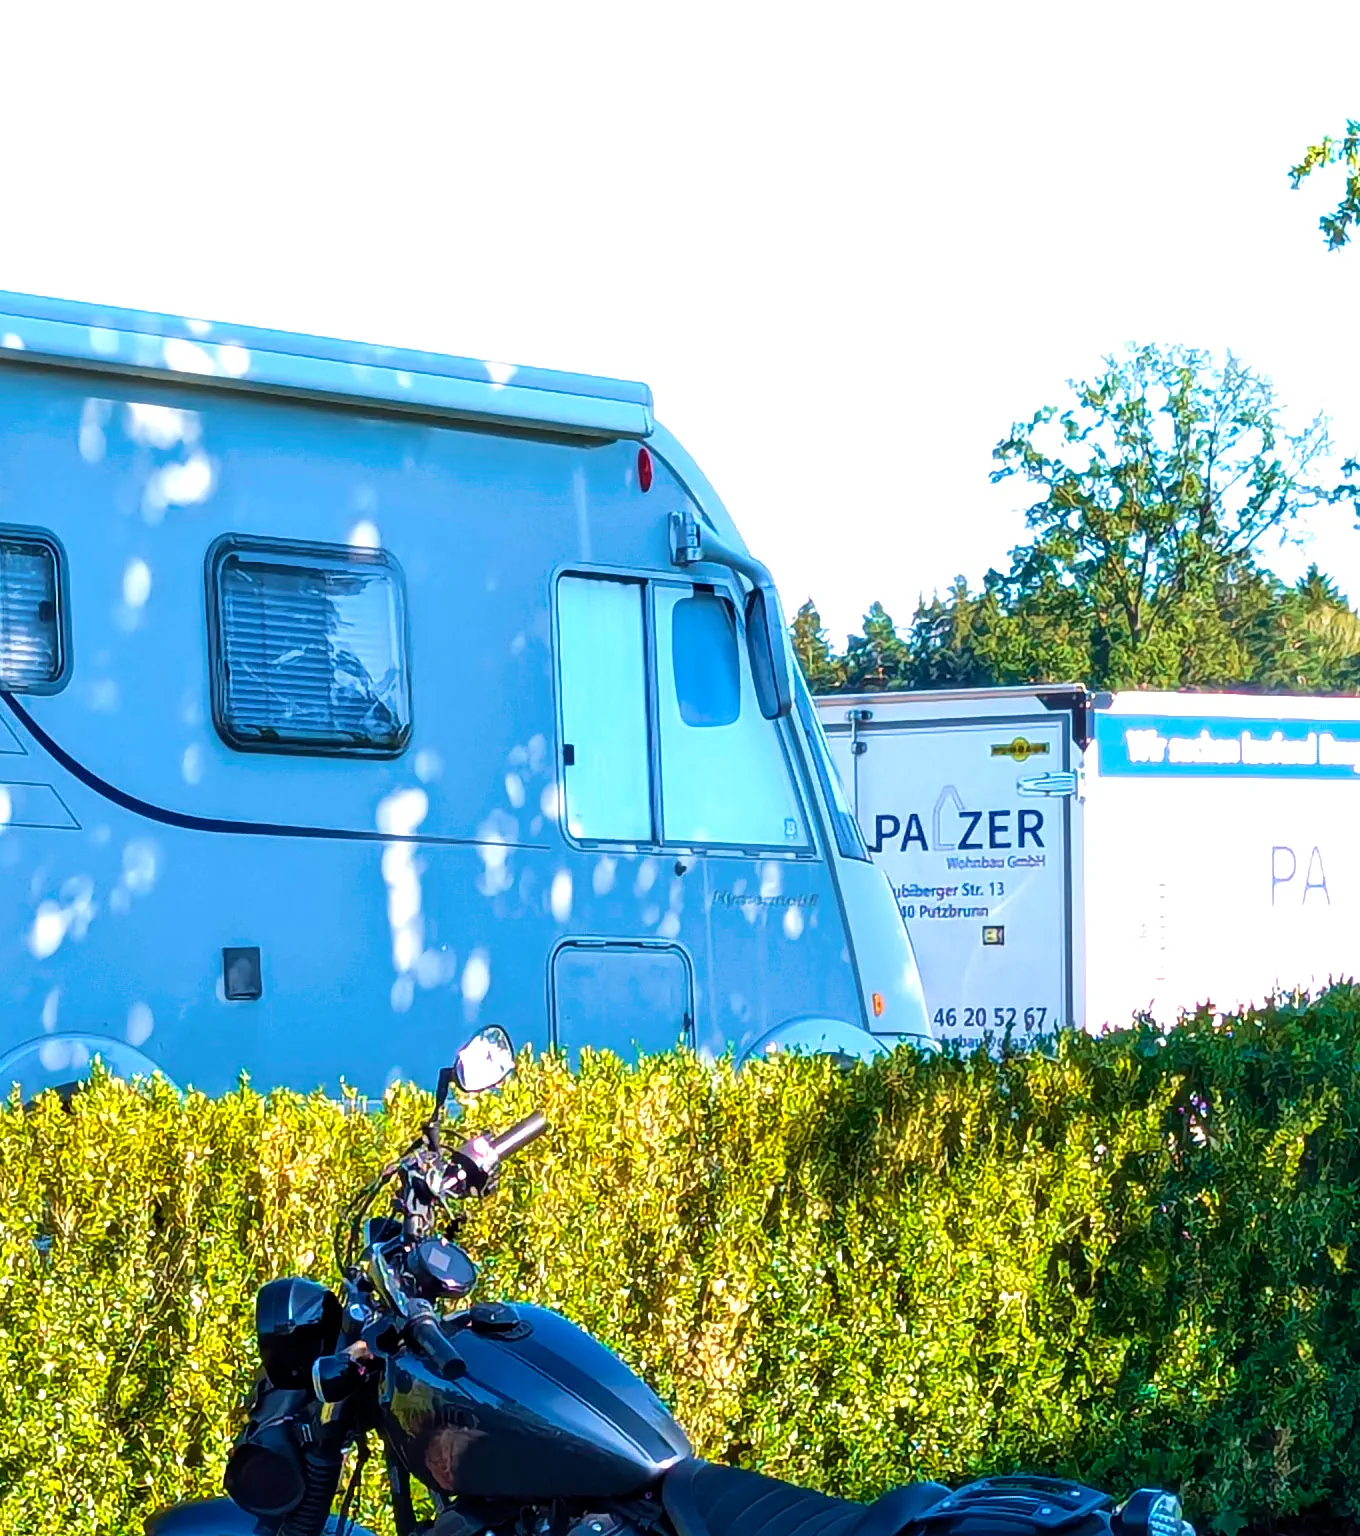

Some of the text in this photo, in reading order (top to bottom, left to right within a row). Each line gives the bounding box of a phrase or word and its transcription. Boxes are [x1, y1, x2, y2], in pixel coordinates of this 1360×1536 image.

[946, 856, 1005, 870] Wohnbau
[961, 883, 985, 897] Str.
[990, 882, 1005, 896] 13
[919, 904, 989, 918] Putzbrunn
[934, 1007, 1048, 1030] 46 20 52 67
